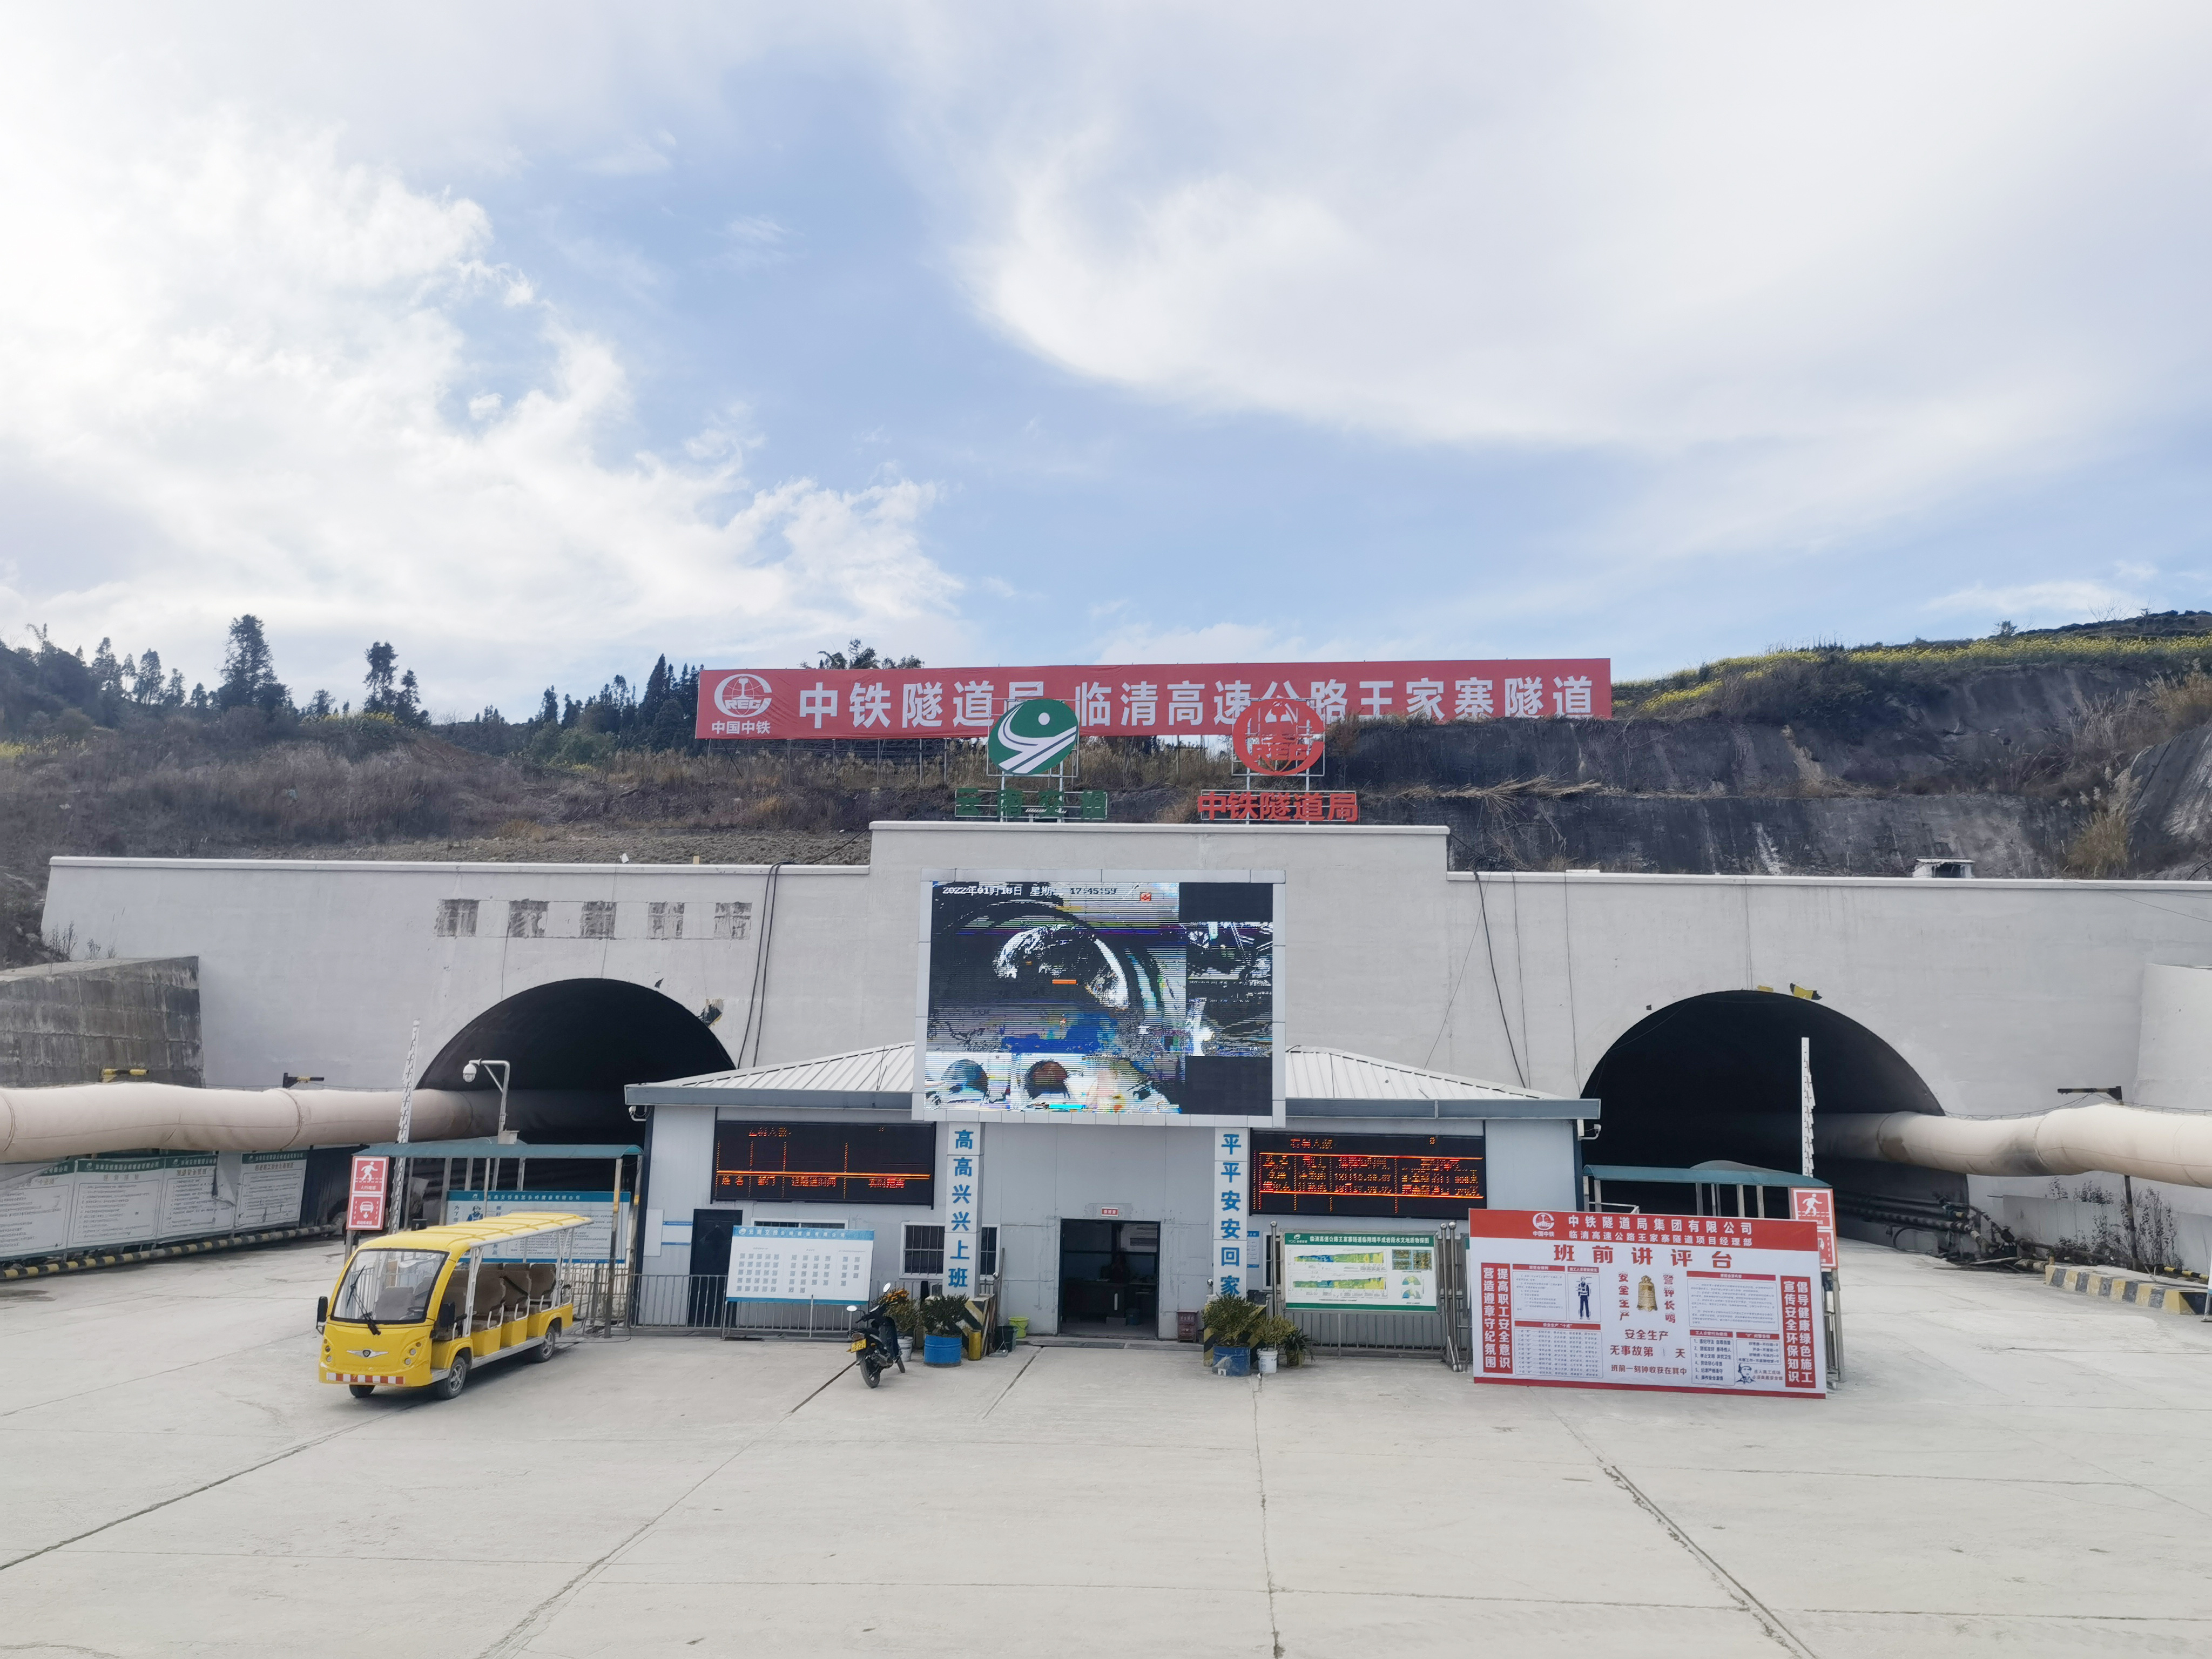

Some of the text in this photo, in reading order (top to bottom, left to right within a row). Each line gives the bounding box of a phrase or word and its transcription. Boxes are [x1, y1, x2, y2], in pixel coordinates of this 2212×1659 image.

[711, 720, 771, 734] 中国中铁
[1197, 791, 1358, 822] 中铁隧道局
[947, 1129, 974, 1287] 高高兴兴上班
[1220, 1134, 1242, 1296] 平平安安回家
[1568, 1214, 1752, 1235] 中铁隧道局集团有限公司
[1553, 1244, 1732, 1269] 班前讲评台
[1568, 1230, 1752, 1247] 临清高速公路王家寨隧道项目经理部
[1618, 1271, 1630, 1321] 安全生产
[1663, 1273, 1676, 1324] 警钟长鸣
[1483, 1267, 1496, 1368] 营造遵章守纪氛围
[1497, 1267, 1511, 1369] 提高职工安全意识
[1624, 1328, 1669, 1341] 安全生产
[1783, 1280, 1800, 1383] 宣传安全环保知识
[1797, 1281, 1813, 1383] 倡导健康绿色施工
[1609, 1345, 1686, 1359] 无事故第 天
[1610, 1364, 1687, 1375] 班前一刻钟收获在其中
